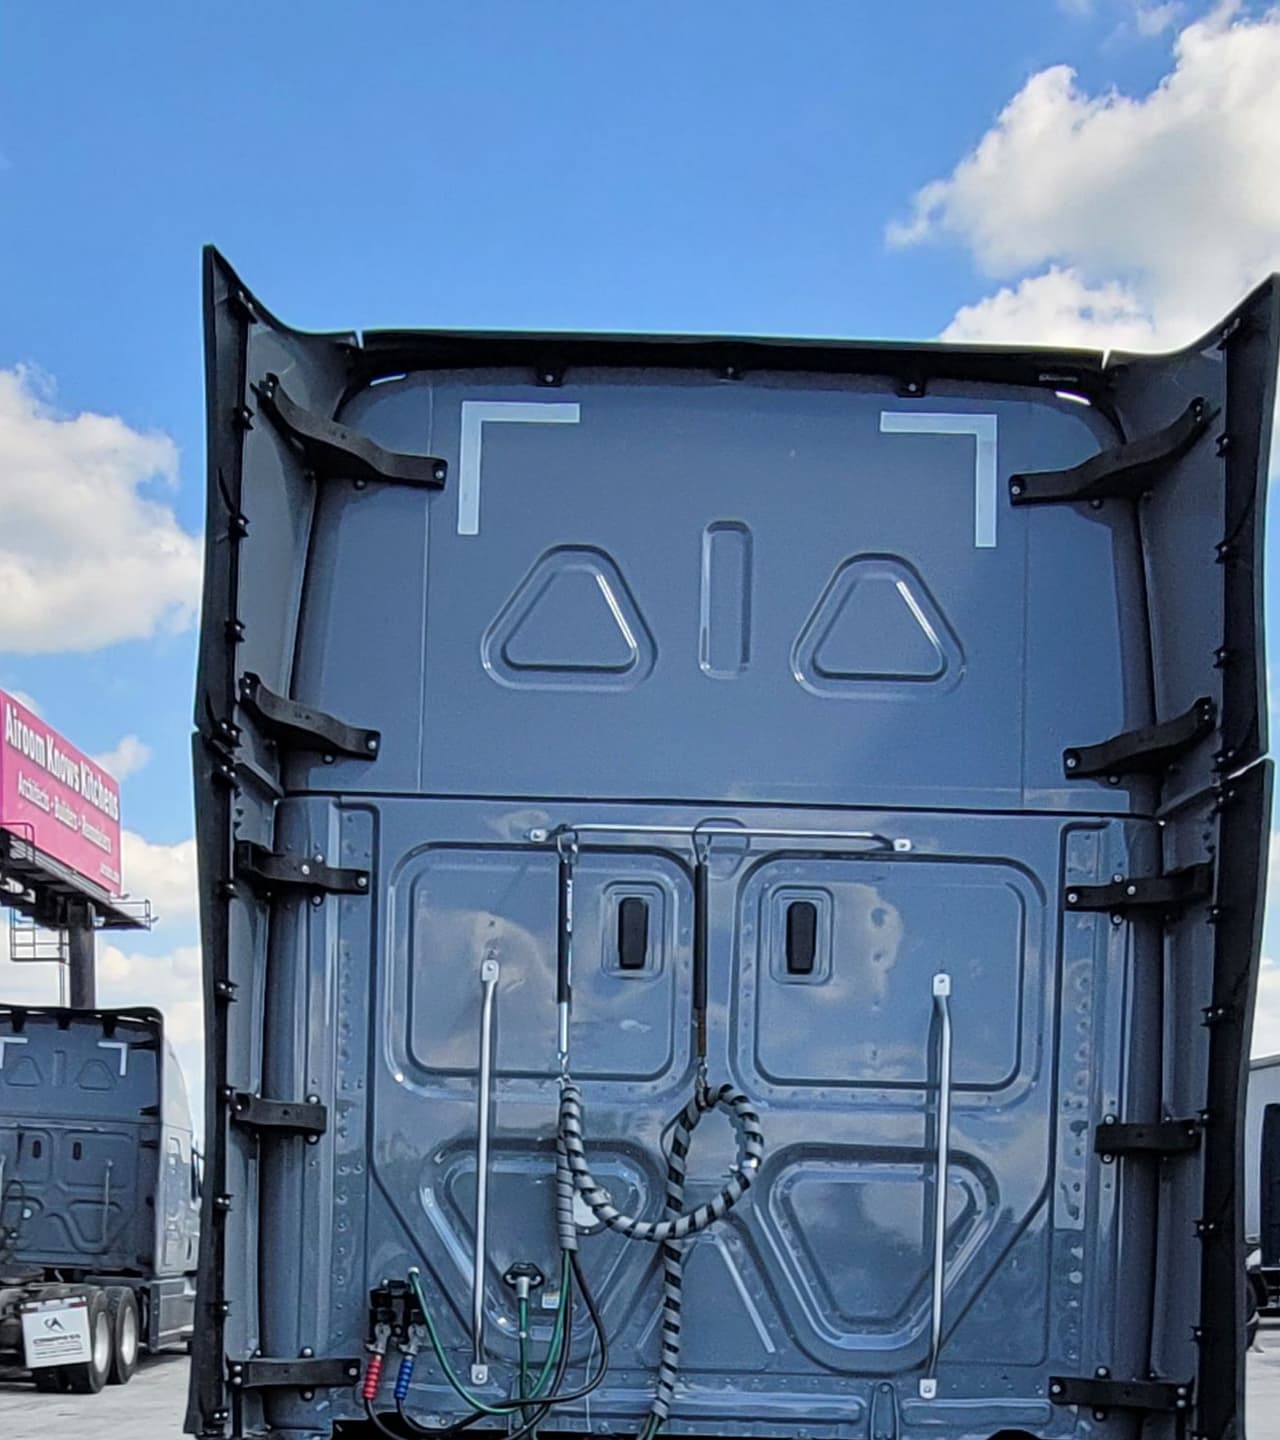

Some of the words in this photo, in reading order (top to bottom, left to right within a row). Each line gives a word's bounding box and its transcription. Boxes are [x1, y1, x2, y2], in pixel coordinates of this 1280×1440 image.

[5, 703, 46, 767] Airoom
[46, 734, 80, 792] Knows
[80, 761, 119, 821] Kitchens
